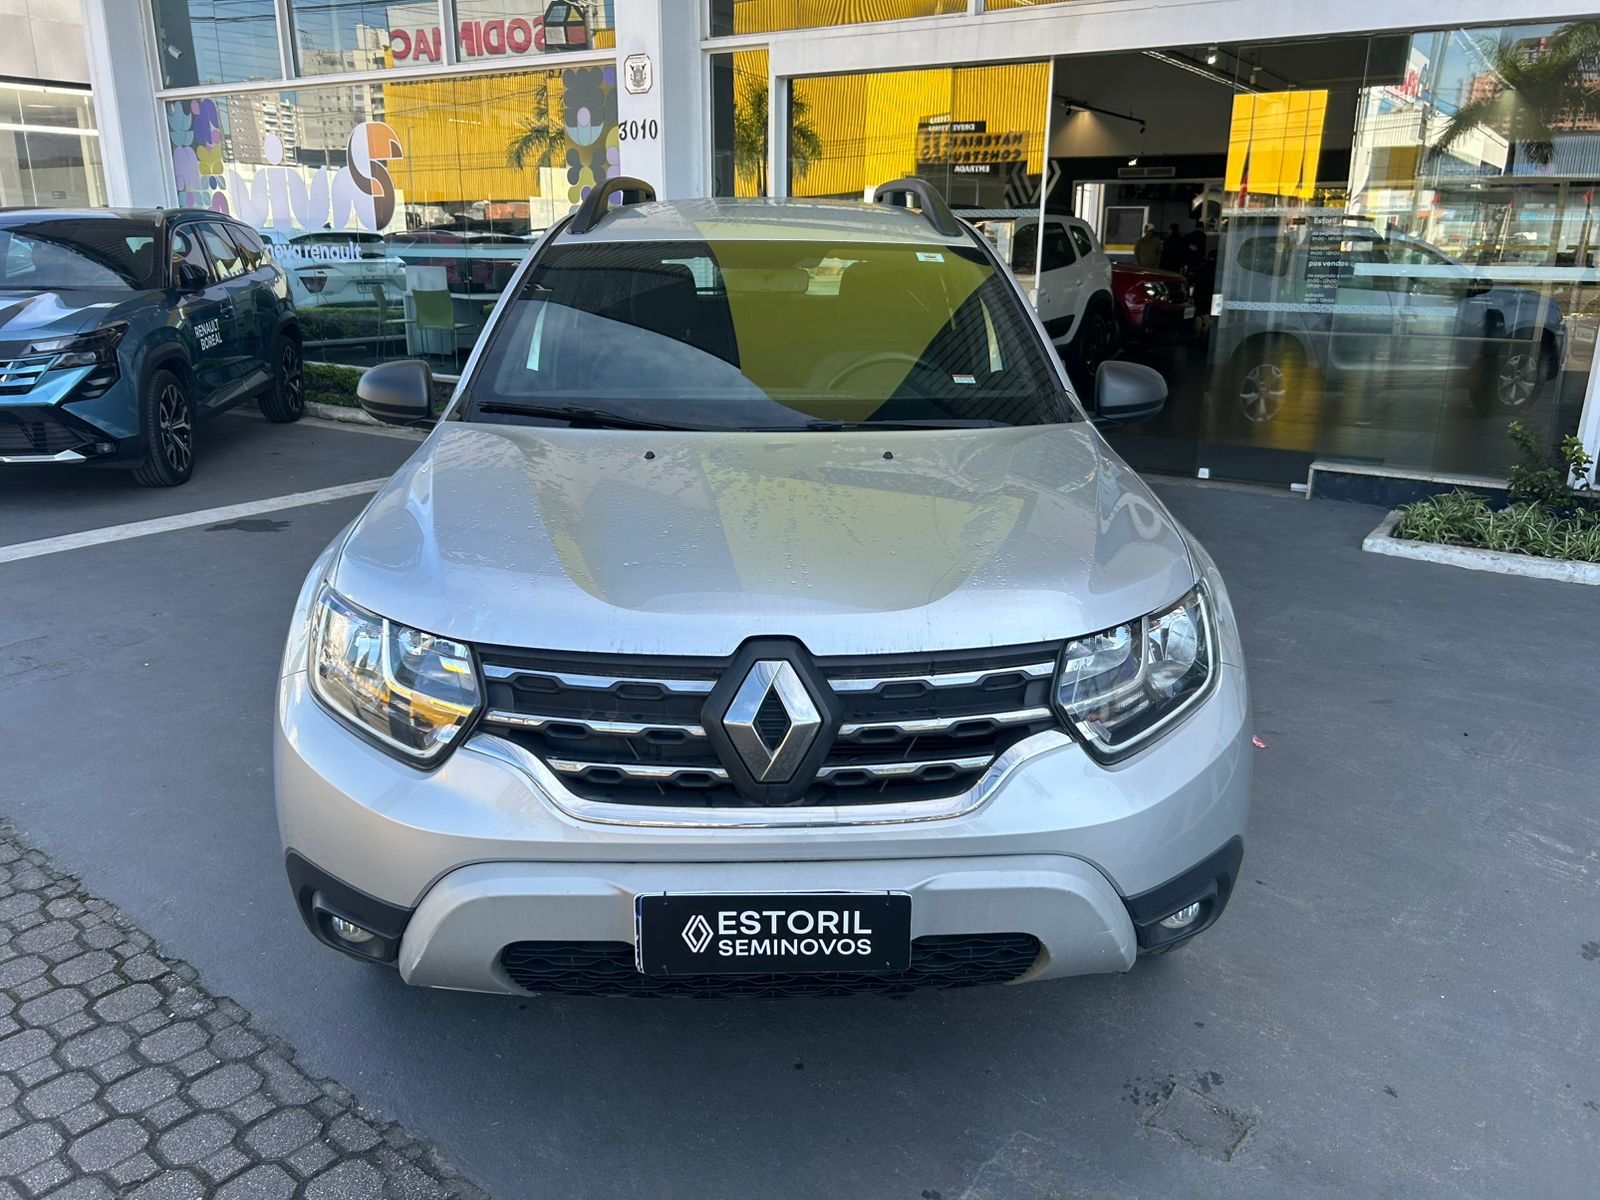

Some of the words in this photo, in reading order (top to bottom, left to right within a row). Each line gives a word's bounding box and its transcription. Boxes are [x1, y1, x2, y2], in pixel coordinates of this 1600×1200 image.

[618, 119, 658, 141] 3010
[304, 240, 363, 260] renault
[194, 318, 220, 339] RENAULT
[200, 331, 223, 350] BOREAL
[718, 910, 872, 935] ESTORIL
[718, 938, 872, 957] SEMINOVOS
